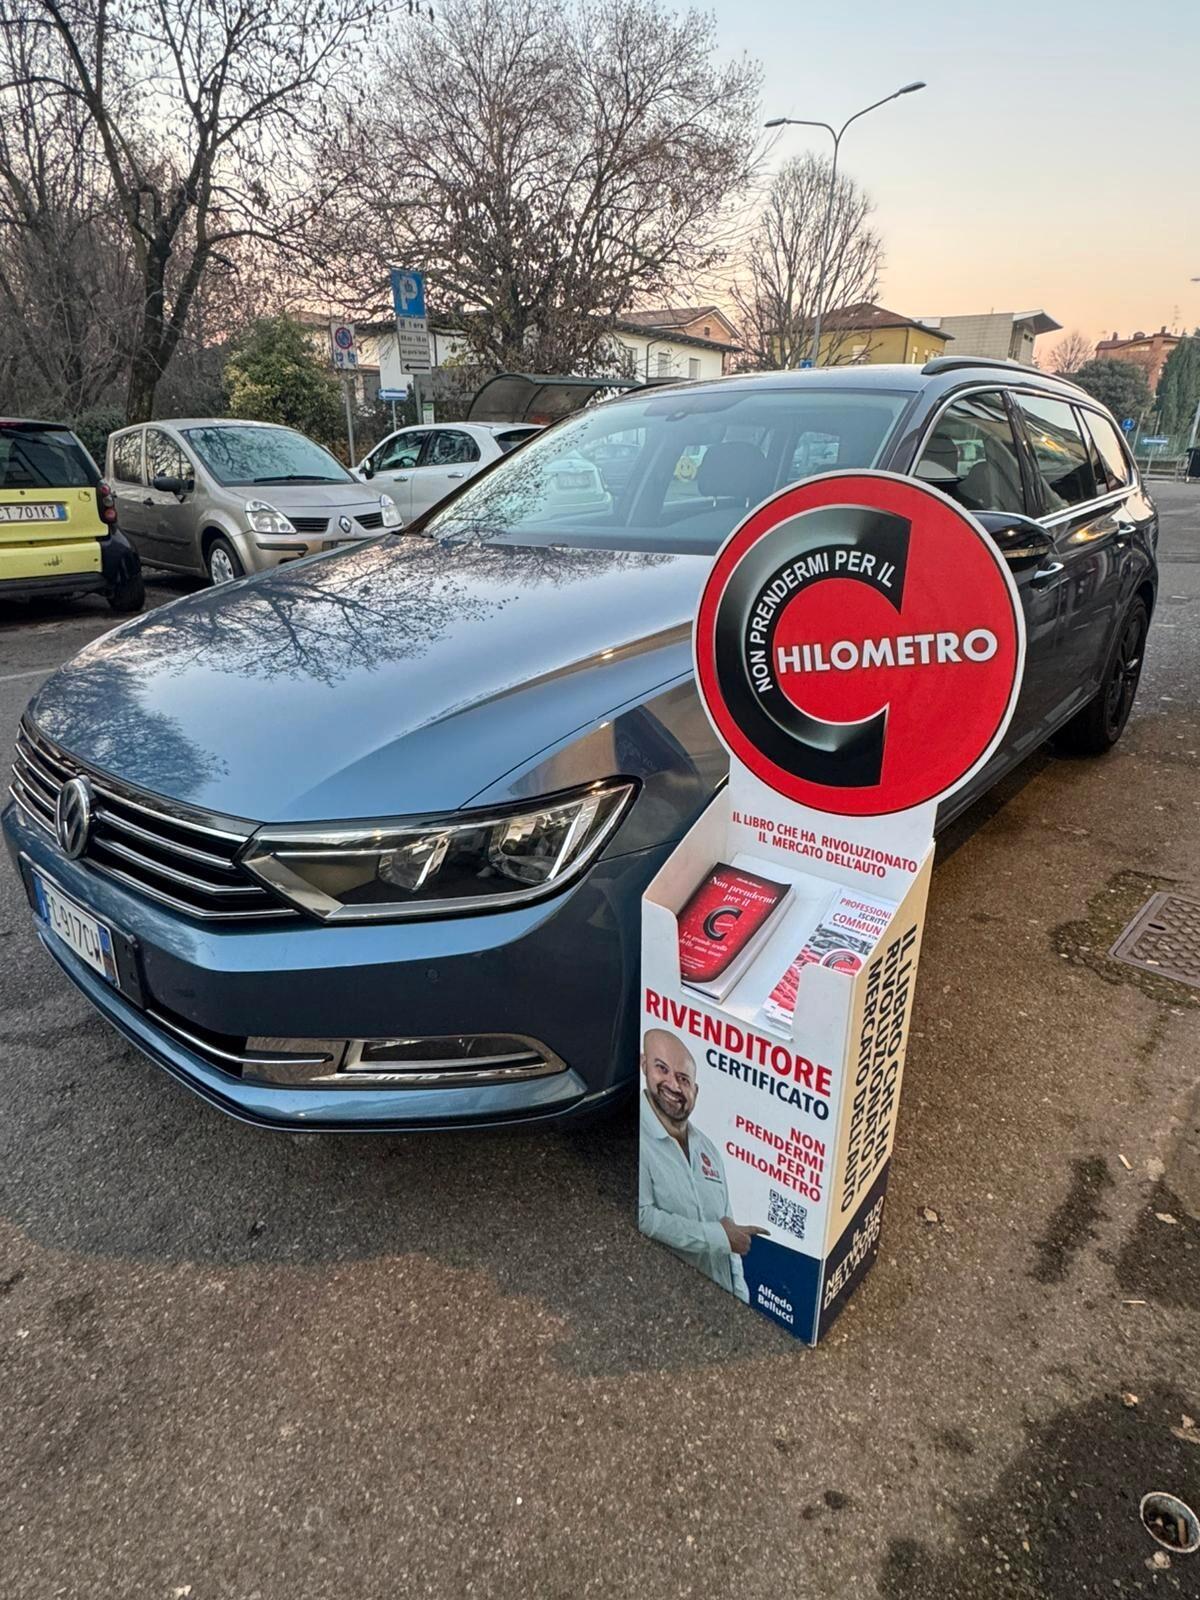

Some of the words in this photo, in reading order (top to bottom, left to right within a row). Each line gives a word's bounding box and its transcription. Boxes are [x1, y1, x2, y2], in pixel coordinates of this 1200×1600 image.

[17, 505, 56, 519] 701KT
[834, 550, 877, 577] PER
[876, 561, 897, 588] IL
[749, 553, 830, 645] PRENDERMI
[750, 651, 774, 693] NON
[732, 811, 743, 824] IL
[743, 814, 775, 833] LIBRO
[777, 823, 799, 839] CHE
[800, 829, 816, 844] HA
[821, 835, 918, 874] RIVOLUZIONATO
[758, 831, 768, 845] IL
[772, 835, 824, 860] MERCATO
[826, 849, 887, 878] DELL'AUTO
[710, 876, 728, 889] Non
[728, 884, 778, 905] prendermi
[723, 894, 742, 904] per
[741, 897, 751, 907] il
[832, 913, 883, 936] COMMUN
[900, 924, 918, 959] IL
[856, 955, 884, 1087] MERCATO
[887, 958, 913, 1059] LIBRO
[645, 987, 833, 1098] RIVENDITORE
[861, 936, 902, 1162] RIVOLUZIONATO
[705, 1048, 829, 1121] CERTIFICATO
[878, 1060, 898, 1125] CHE
[735, 1114, 824, 1173] PRENDERMI
[790, 1127, 826, 1158] NON
[841, 1085, 868, 1214] DELL'AUTO
[872, 1119, 891, 1172] HA
[725, 1140, 822, 1204] CHILOMETRO
[777, 1152, 806, 1180] PER
[810, 1165, 824, 1190] IL
[857, 1159, 873, 1194] IL
[864, 1195, 884, 1228] TUO
[757, 1294, 795, 1326] Bellucci
[758, 1283, 793, 1313] Alfredo
